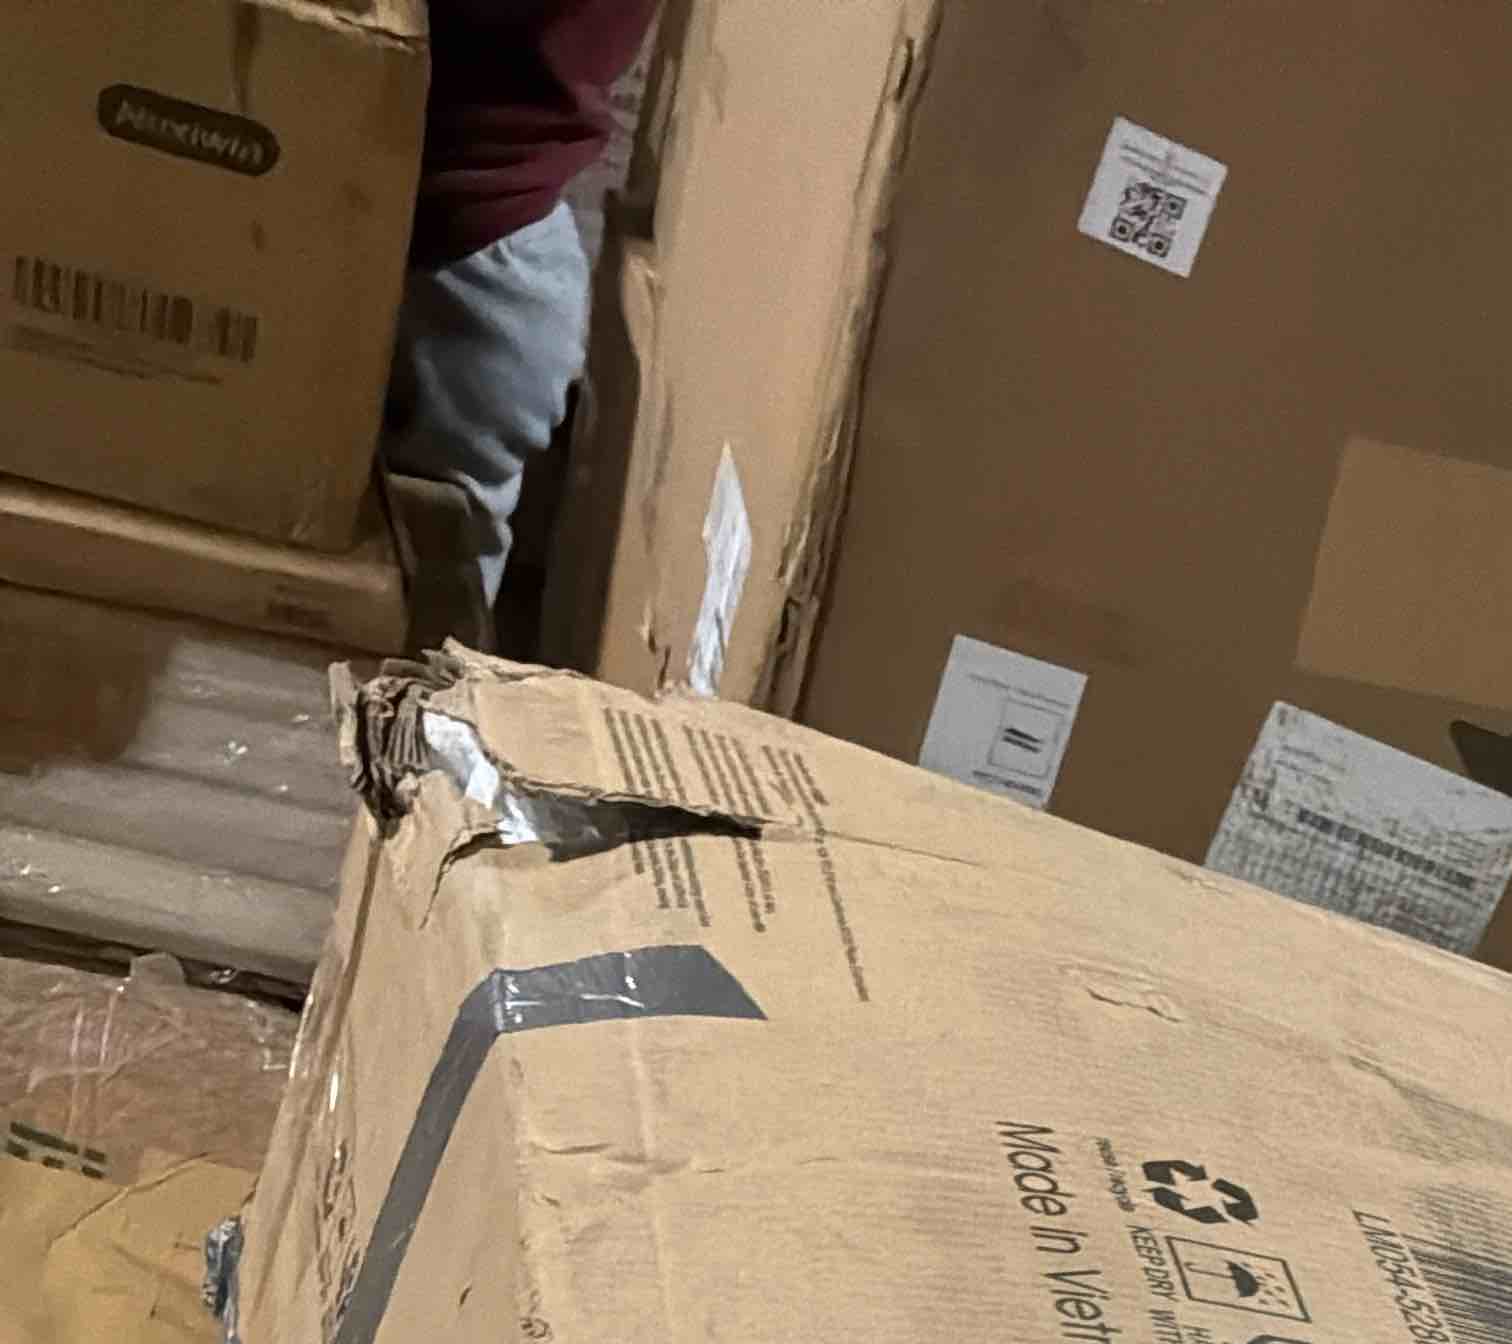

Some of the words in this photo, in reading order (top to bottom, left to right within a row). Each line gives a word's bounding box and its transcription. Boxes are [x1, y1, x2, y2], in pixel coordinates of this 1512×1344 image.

[995, 1120, 1077, 1217] Made
[1125, 1224, 1166, 1267] KEEP
[1142, 1264, 1180, 1302] DRY
